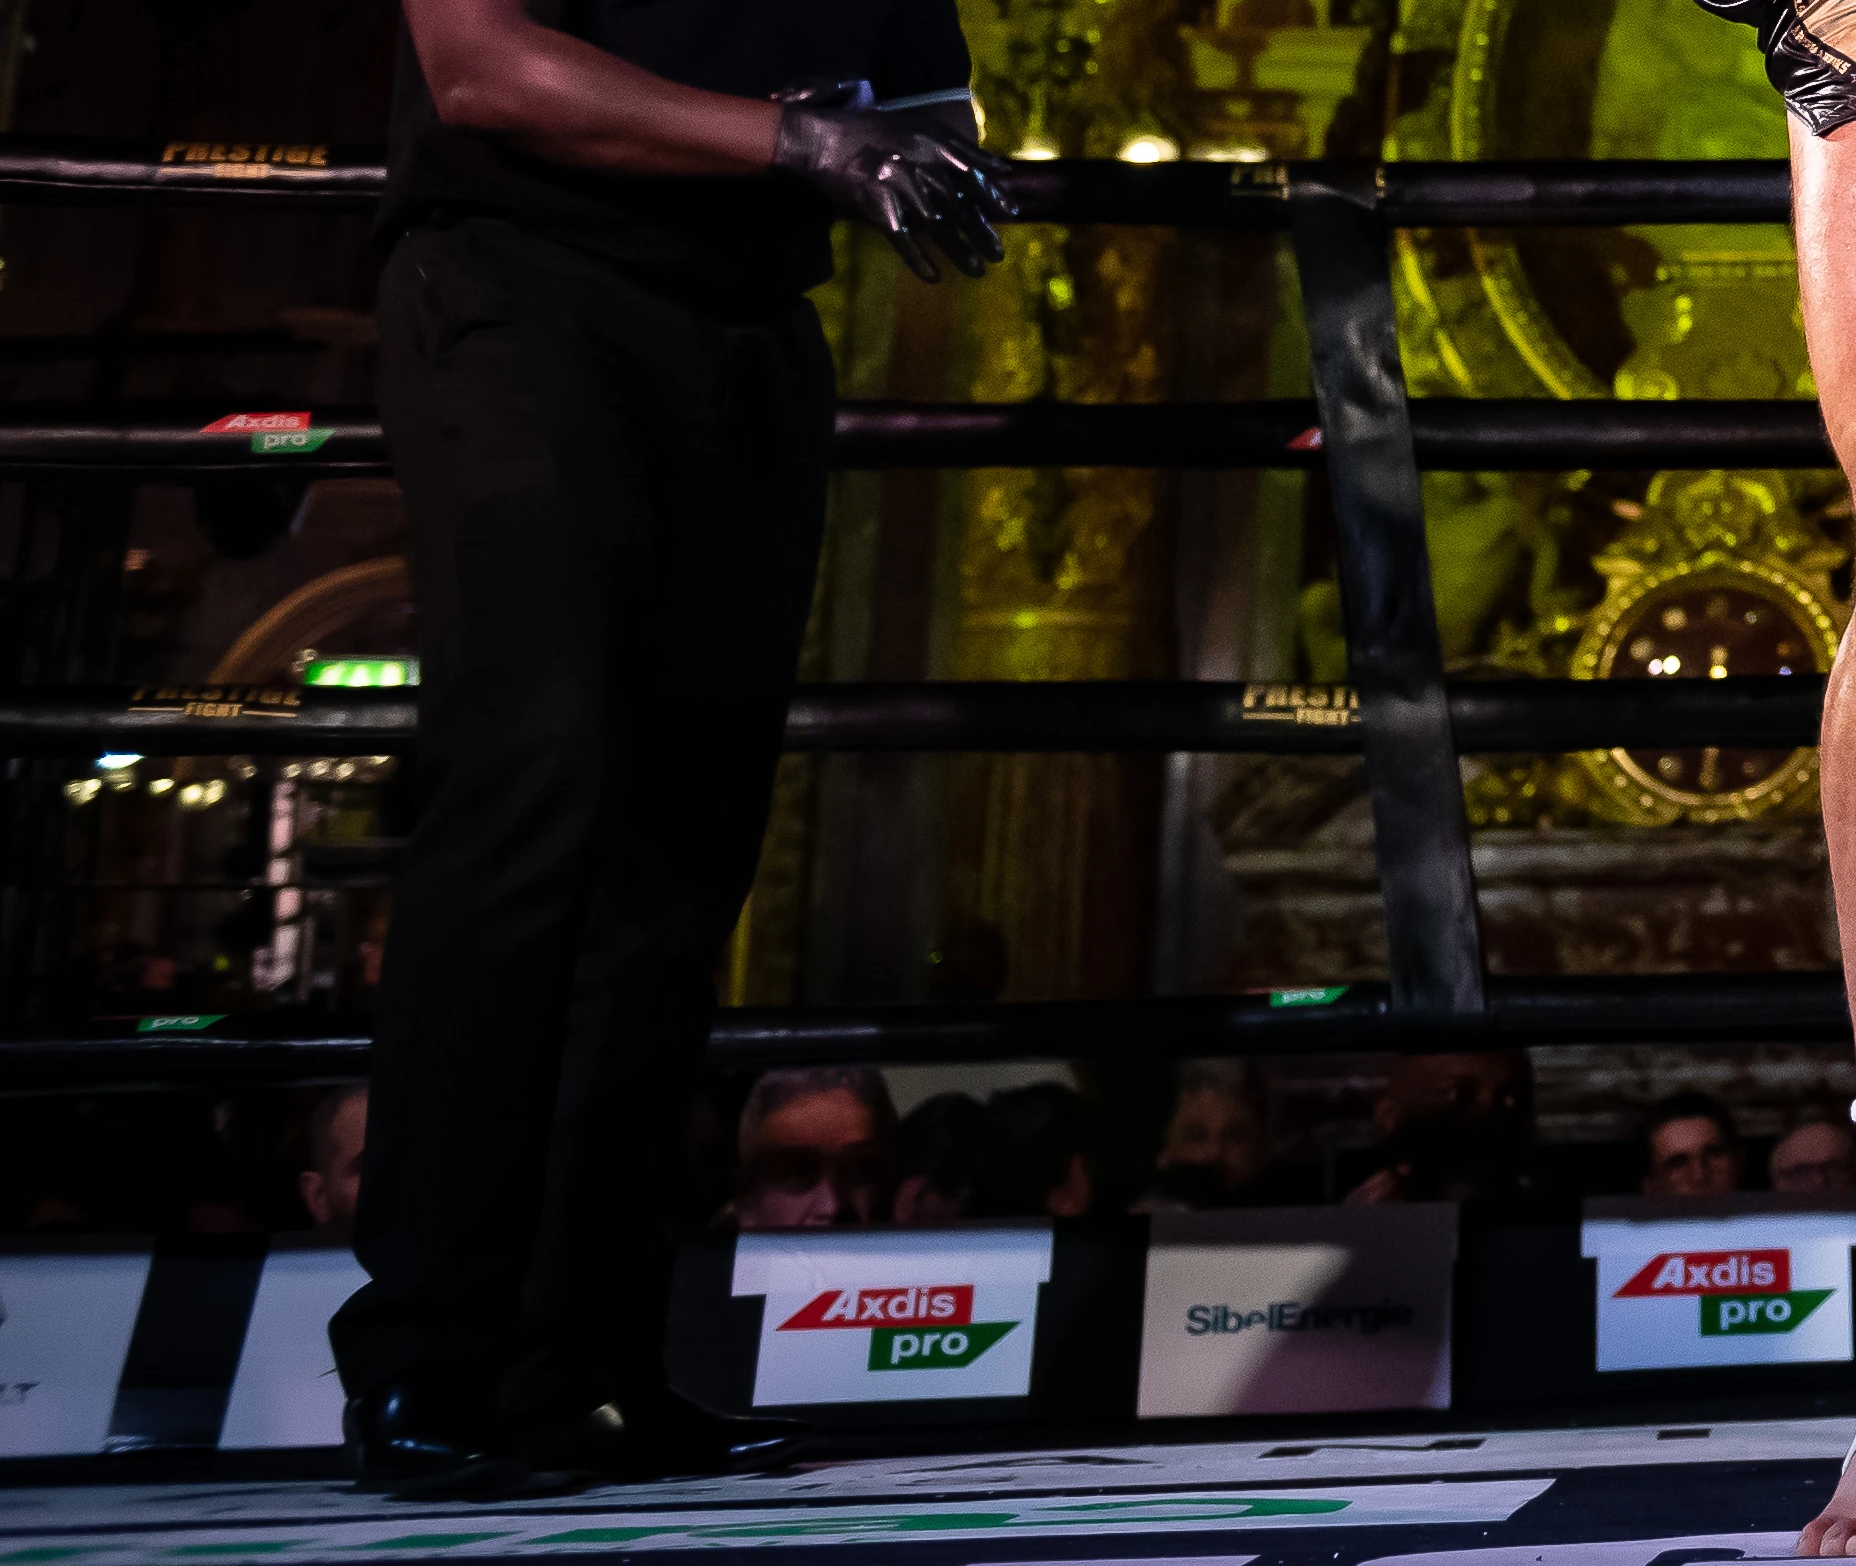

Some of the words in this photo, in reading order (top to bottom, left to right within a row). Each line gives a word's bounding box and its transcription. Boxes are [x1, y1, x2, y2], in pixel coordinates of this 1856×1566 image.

[264, 432, 310, 451] pro
[1649, 1252, 1776, 1290] Axdis
[822, 1287, 957, 1323] Axdis
[1186, 1297, 1414, 1336] SibelEnergie
[1717, 1294, 1793, 1333] pro
[889, 1327, 969, 1365] pro
